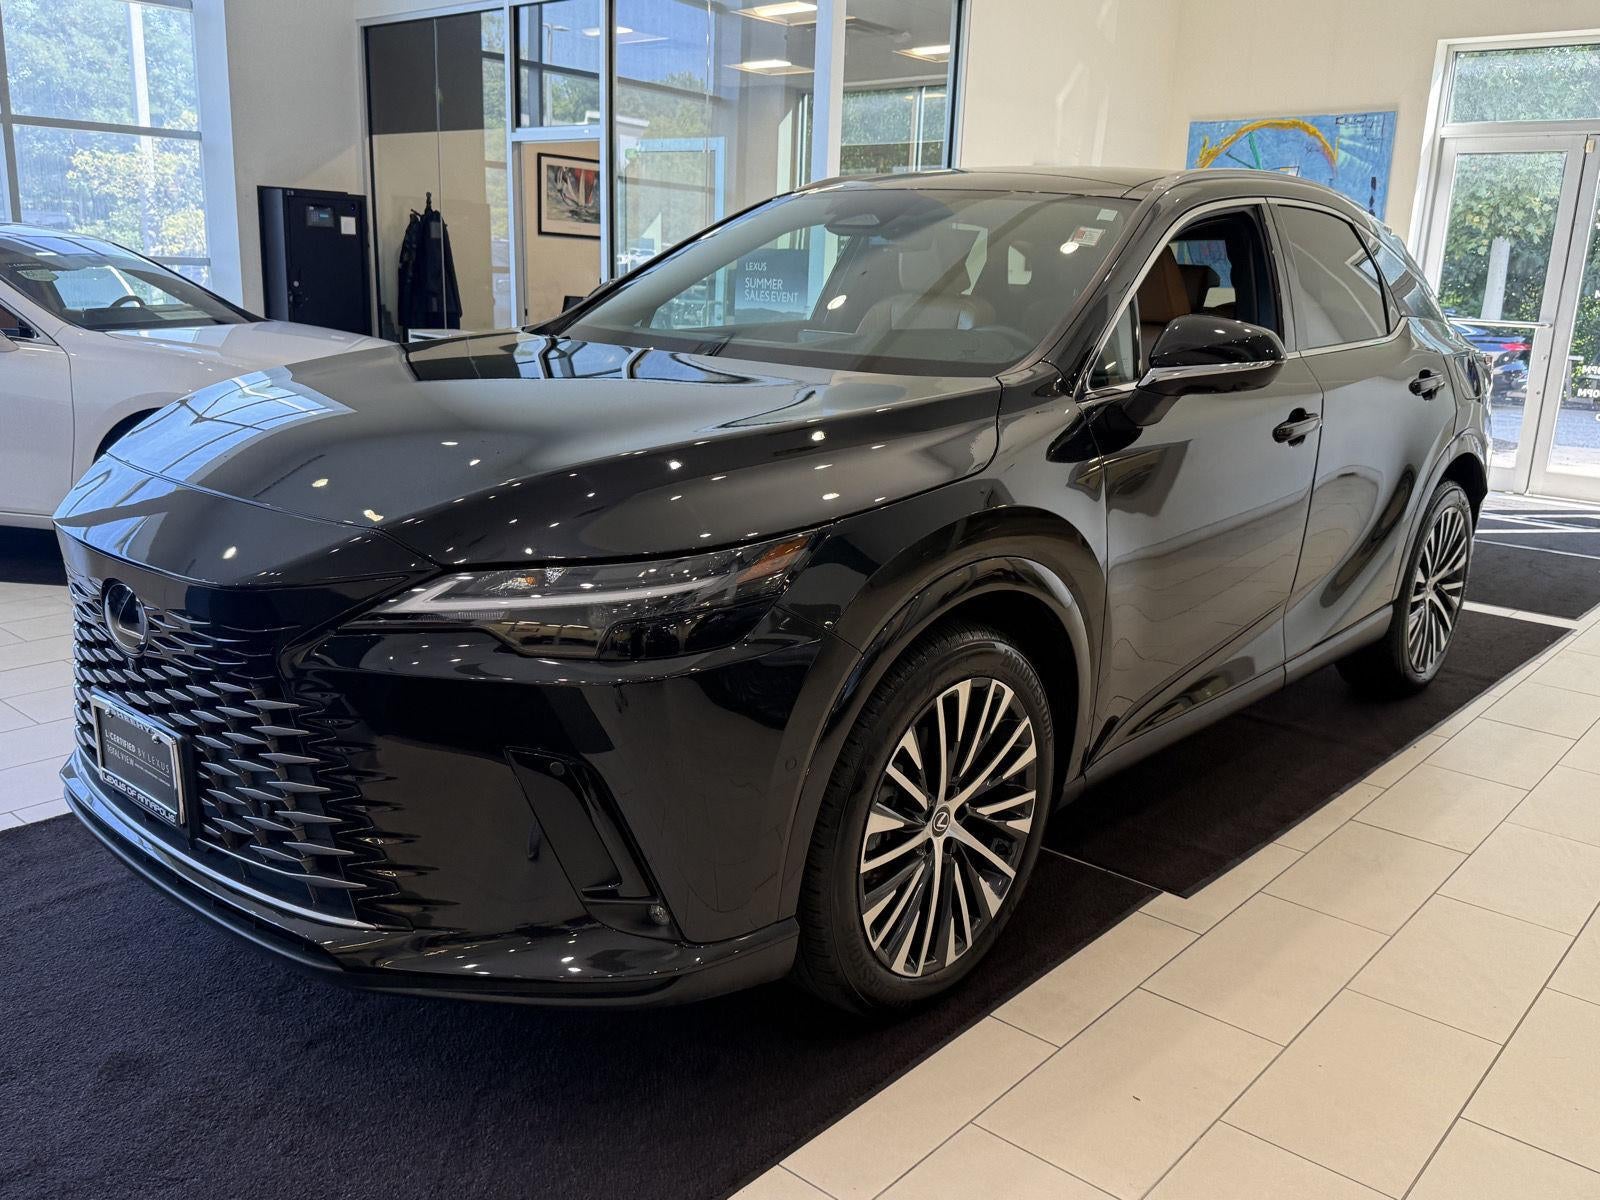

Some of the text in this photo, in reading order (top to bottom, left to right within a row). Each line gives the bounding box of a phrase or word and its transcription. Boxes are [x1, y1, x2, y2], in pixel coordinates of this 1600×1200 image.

[745, 262, 767, 271] LEXUS
[745, 277, 783, 290] SUMMER
[744, 289, 799, 303] SALES EVENT
[147, 754, 170, 773] LEXUS
[103, 772, 127, 791] LEXUS
[127, 788, 137, 797] OF
[137, 794, 176, 822] ANNAPOLIS
